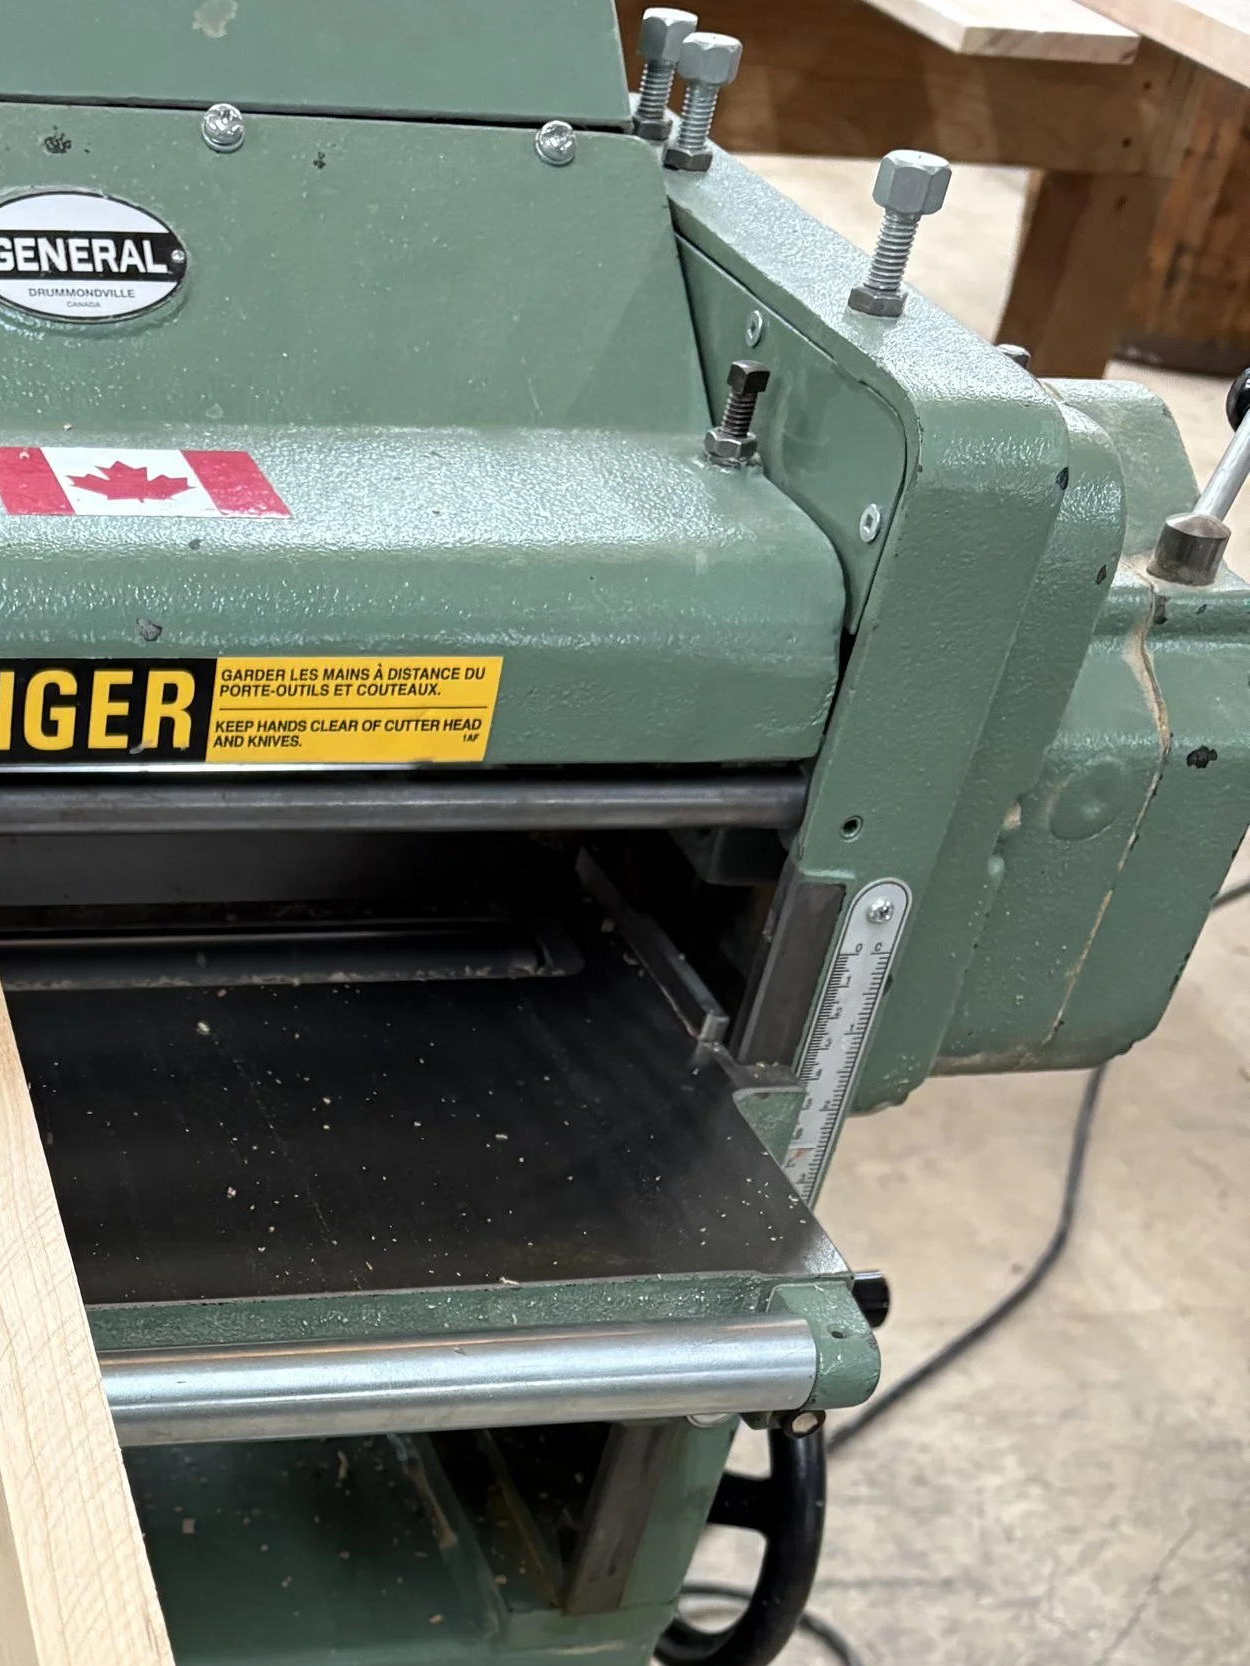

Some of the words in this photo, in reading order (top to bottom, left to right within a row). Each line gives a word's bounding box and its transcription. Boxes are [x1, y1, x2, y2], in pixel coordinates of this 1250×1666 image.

[28, 287, 136, 299] DRUMMONDVILLE
[221, 668, 285, 682] GARDER
[290, 667, 318, 681] LES
[322, 667, 369, 681] MAINS
[373, 663, 384, 680] À
[387, 667, 461, 680] DISTANCE
[464, 666, 486, 680] DU
[219, 684, 330, 697] PORTE-OUTILS
[333, 684, 352, 696] ET
[355, 683, 442, 697] COUTEAUX.
[215, 720, 254, 733] KEEP
[257, 720, 307, 733] HANDS
[310, 720, 358, 732] CLEAR
[361, 719, 382, 732] OF
[385, 719, 440, 731] CUTTER
[442, 718, 482, 731] HEAD
[213, 735, 244, 748] AND
[247, 735, 302, 748] KNIVES.
